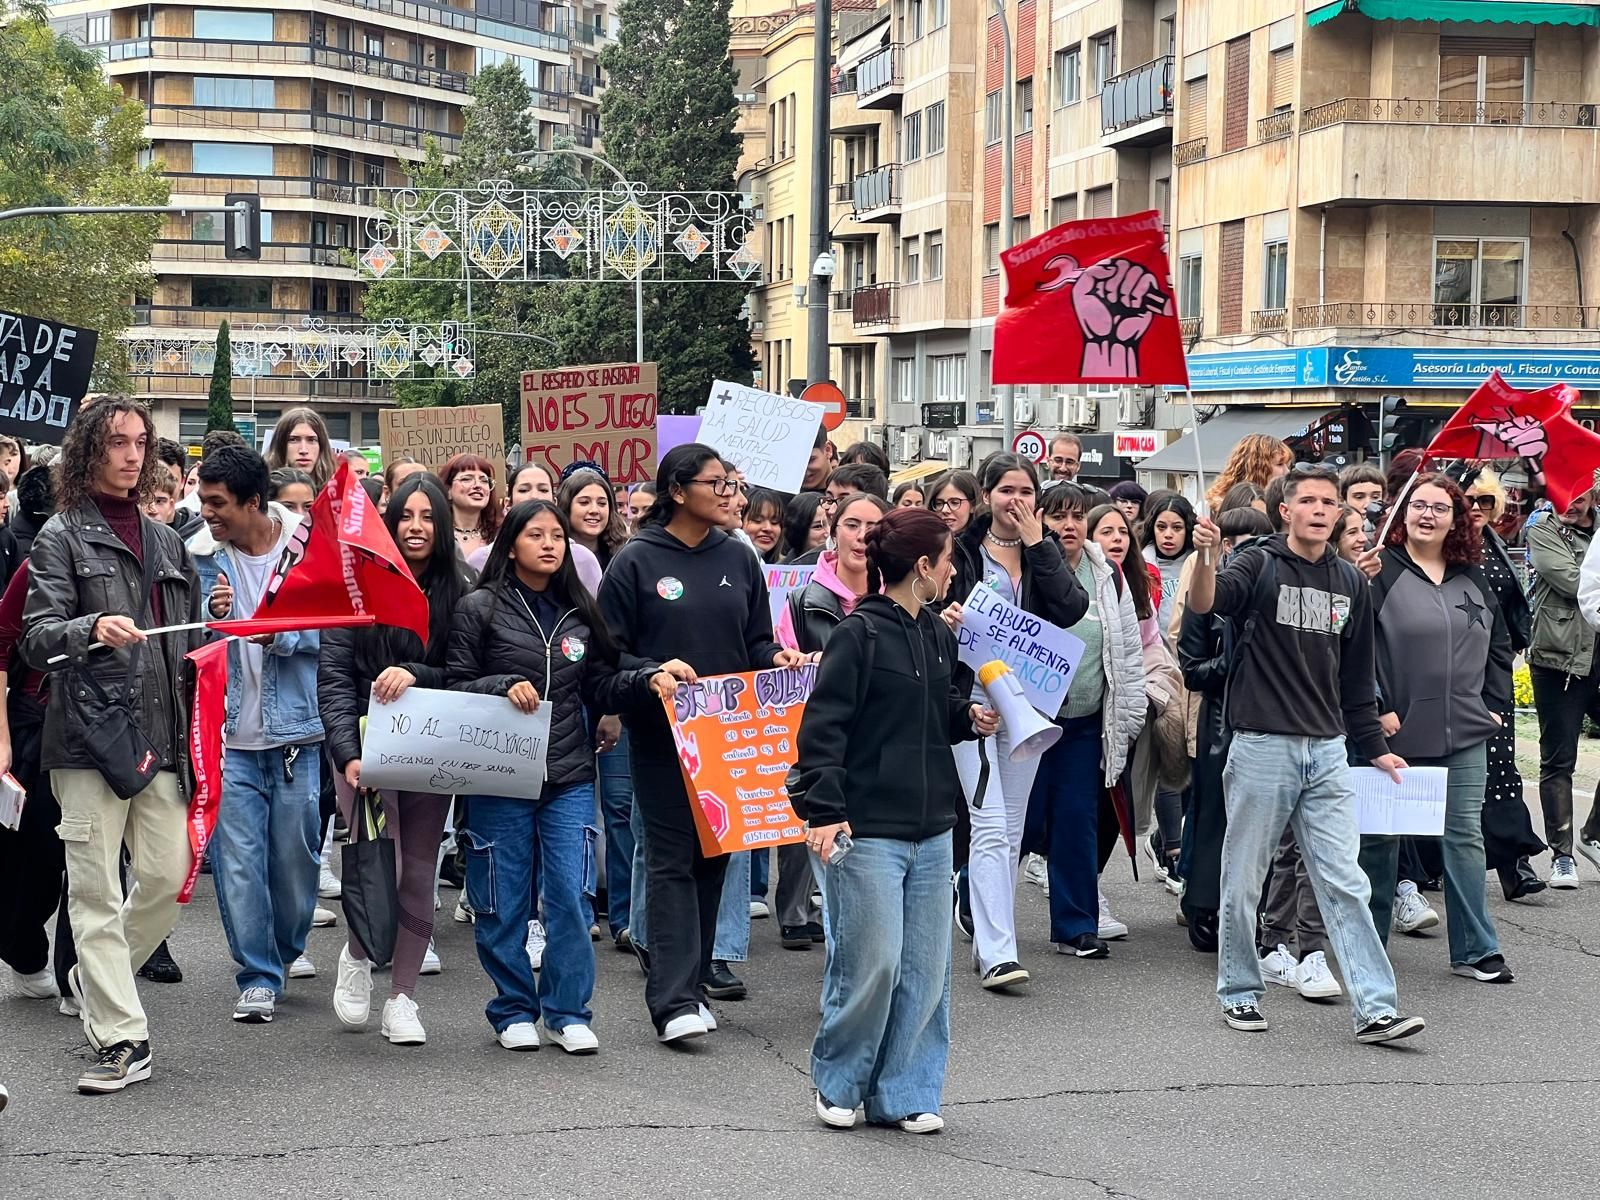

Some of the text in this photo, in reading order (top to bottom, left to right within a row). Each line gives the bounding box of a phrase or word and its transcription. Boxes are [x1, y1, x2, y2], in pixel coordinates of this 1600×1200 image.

[1008, 227, 1086, 268] Sindicato
[33, 323, 77, 362] DE
[34, 358, 52, 391] A
[523, 373, 539, 391] EL
[541, 370, 584, 391] RESPETO
[587, 369, 600, 387] SE
[1413, 362, 1463, 374] Asesoría
[1518, 364, 1551, 375] Fiscal
[1554, 366, 1562, 376] y
[391, 407, 485, 428] EL BULLYING
[527, 396, 559, 432] NO
[562, 392, 589, 431] ES
[733, 390, 816, 422] RECURSOS
[390, 424, 491, 447] NO ES UN JUEGO
[736, 415, 790, 442] SALUD
[715, 433, 772, 456] MENTAL
[1020, 442, 1039, 454] 30
[968, 588, 1041, 637] EL ABUSO
[958, 626, 981, 652] DE
[986, 624, 1071, 676] SE ALIMENTA
[391, 713, 411, 734] NO
[420, 717, 443, 738] AL
[380, 753, 433, 765] DESCANSA
[441, 760, 459, 768] EN
